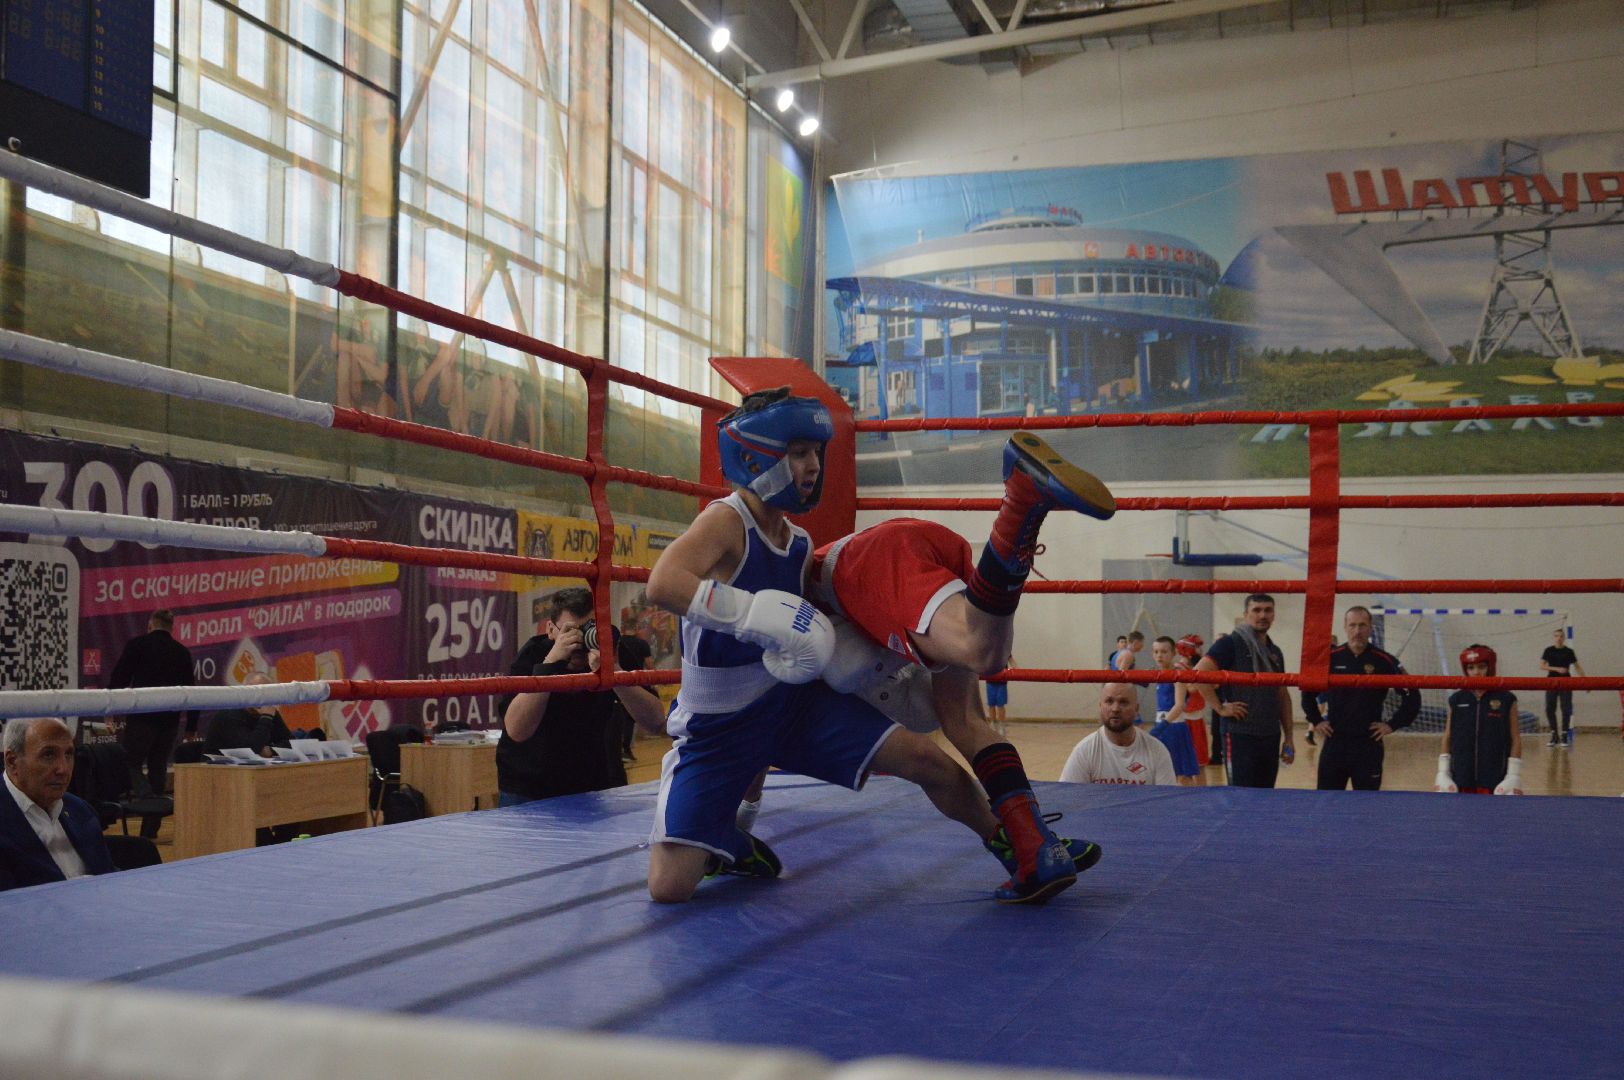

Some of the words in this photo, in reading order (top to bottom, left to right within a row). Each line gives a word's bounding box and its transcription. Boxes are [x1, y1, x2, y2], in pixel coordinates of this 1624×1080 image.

[24, 461, 173, 552] 300
[419, 505, 514, 551] СКИДКА
[95, 580, 124, 603] за
[131, 567, 265, 600] скачивание
[269, 559, 384, 591] приложения
[180, 624, 191, 640] и
[196, 616, 242, 642] ролл
[315, 608, 322, 620] в
[326, 595, 391, 617] подарок
[425, 596, 503, 664] 25%
[422, 694, 497, 727] GOAL
